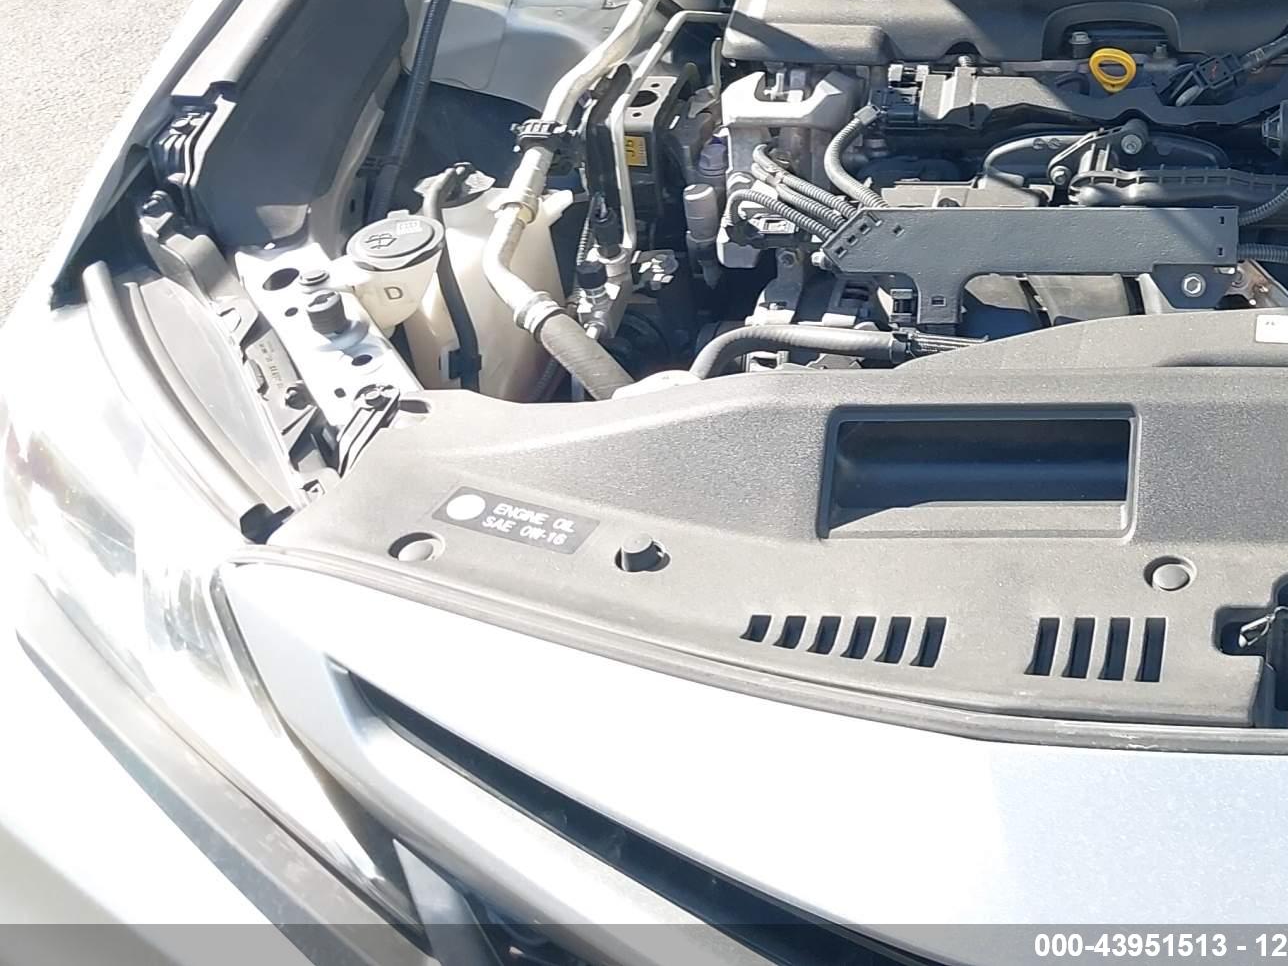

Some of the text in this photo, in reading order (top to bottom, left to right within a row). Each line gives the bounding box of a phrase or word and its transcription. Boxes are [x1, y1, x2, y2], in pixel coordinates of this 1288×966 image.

[384, 286, 404, 300] D
[482, 516, 515, 533] SAE
[493, 503, 576, 533] ENGINE OIL
